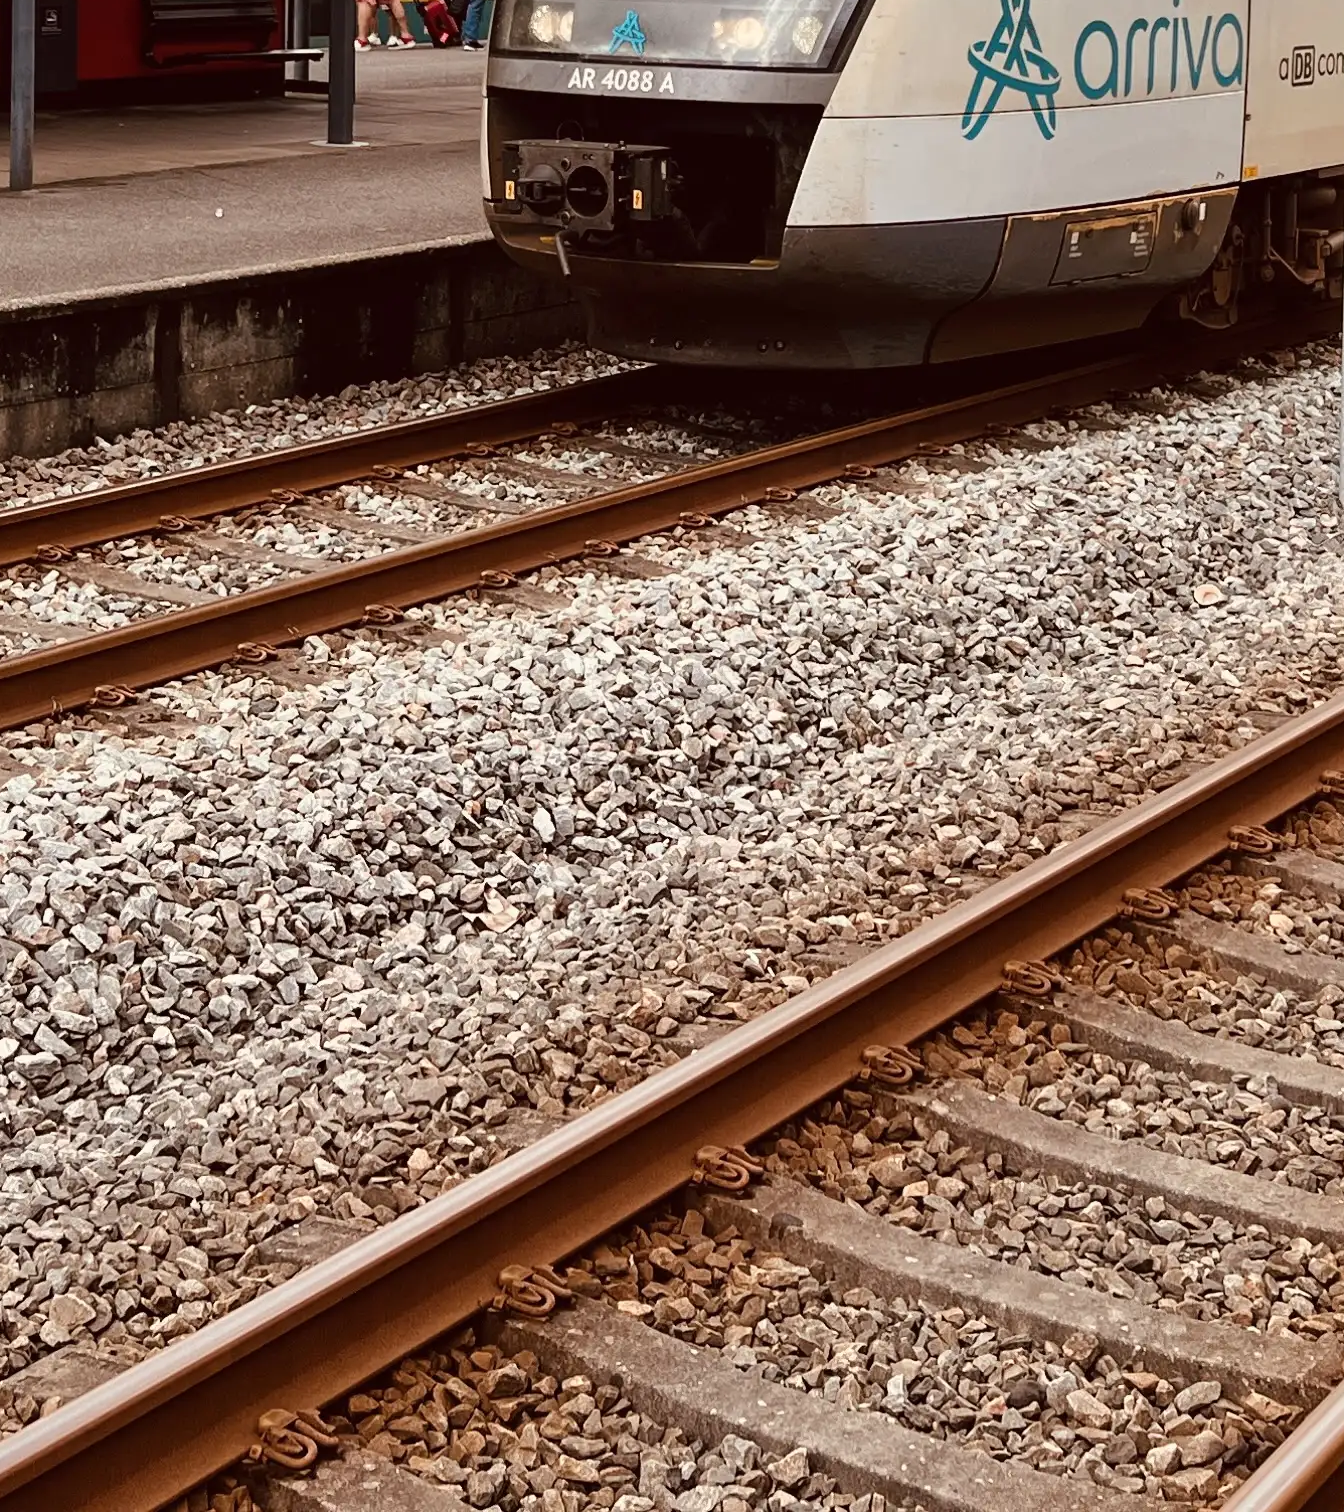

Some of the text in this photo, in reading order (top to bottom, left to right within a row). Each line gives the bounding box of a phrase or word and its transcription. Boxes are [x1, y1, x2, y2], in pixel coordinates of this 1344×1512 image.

[567, 67, 675, 94] AR 4088 A
[1279, 57, 1289, 80] a
[1293, 48, 1313, 83] DB
